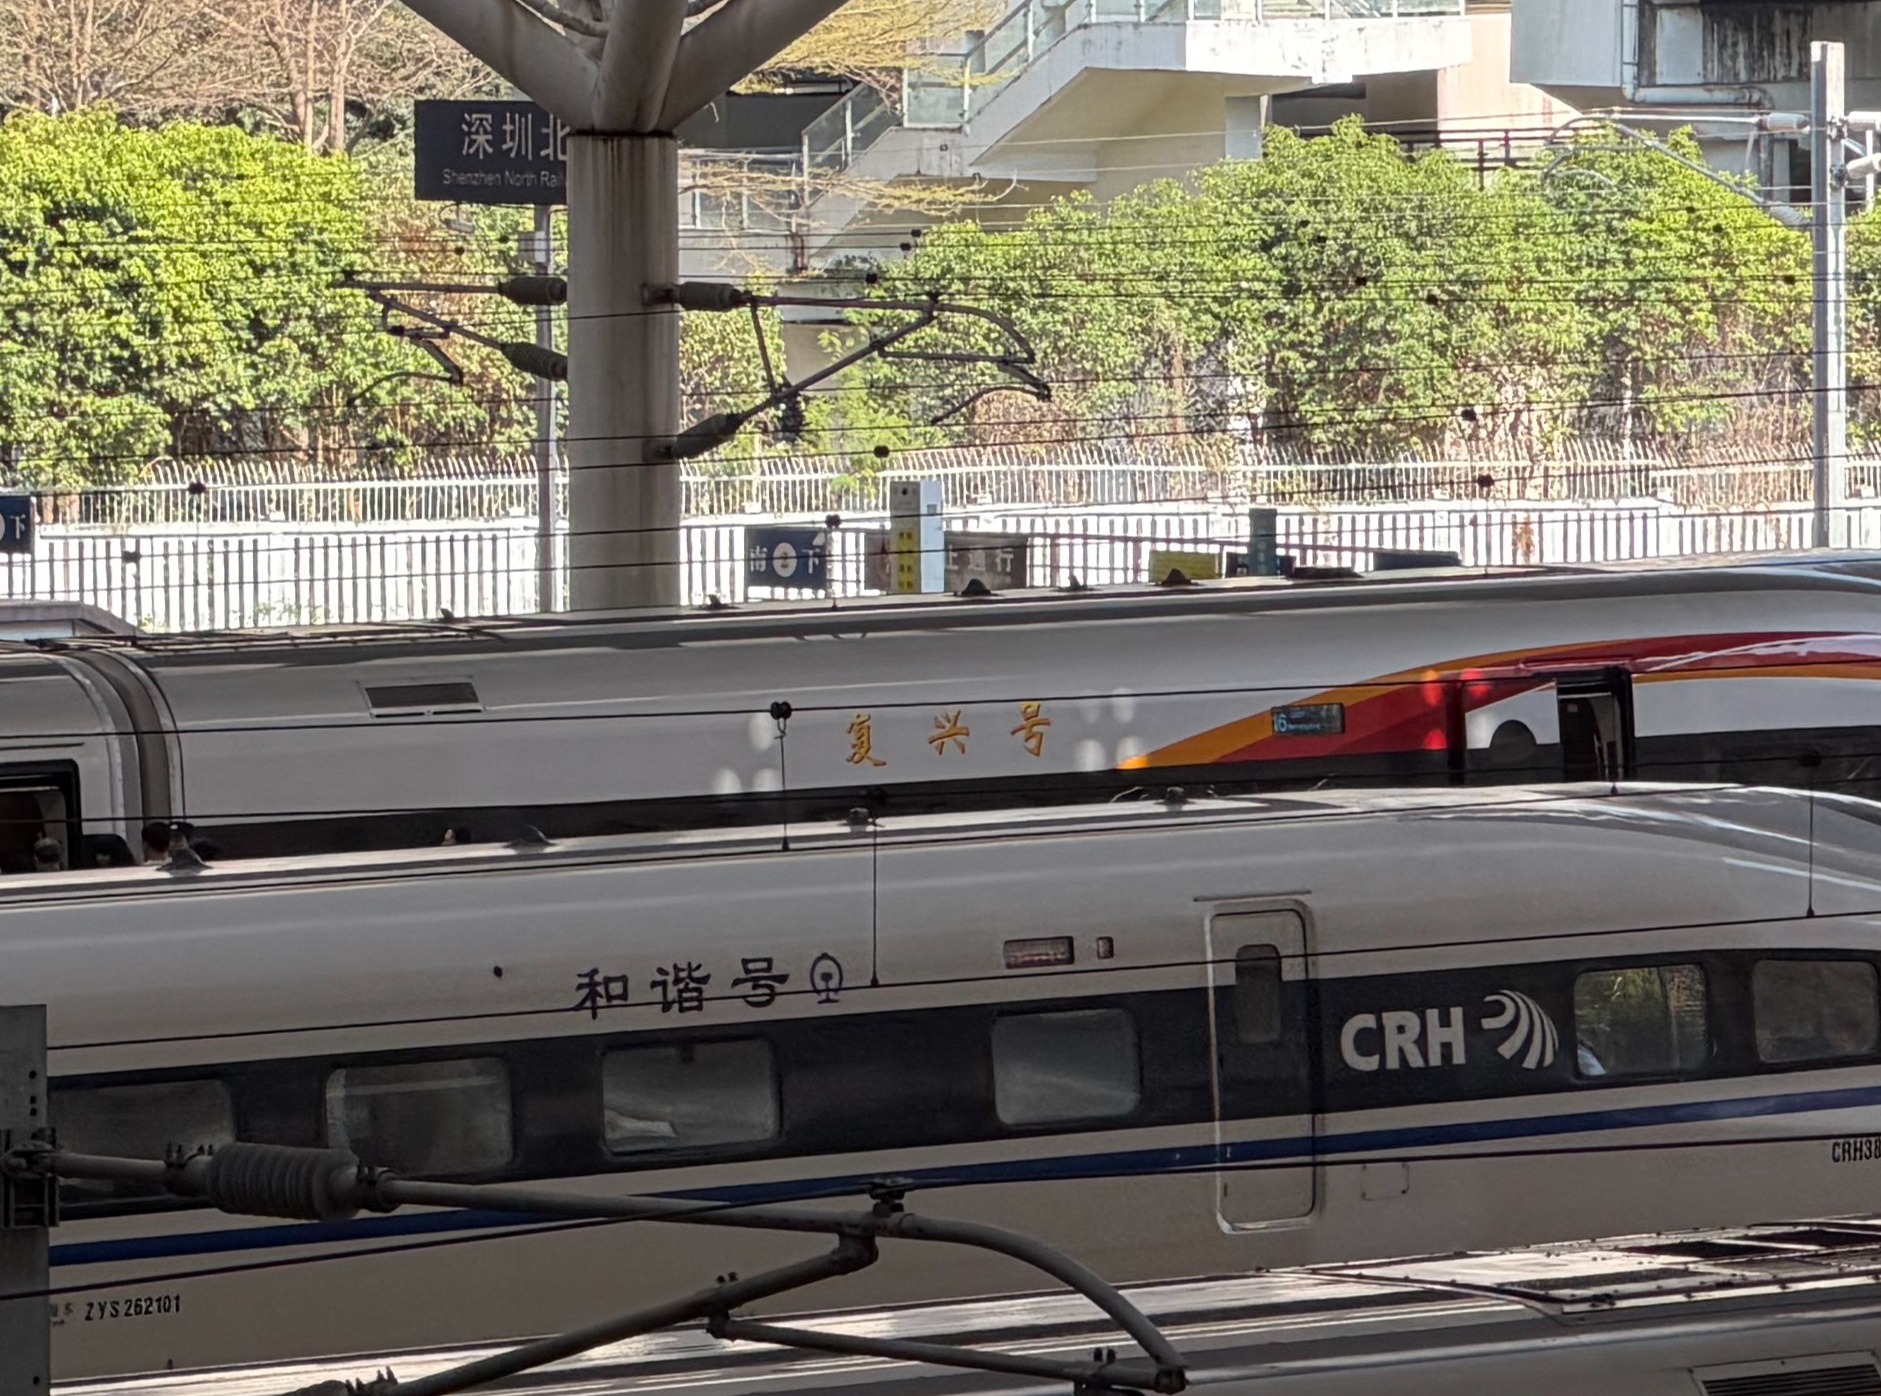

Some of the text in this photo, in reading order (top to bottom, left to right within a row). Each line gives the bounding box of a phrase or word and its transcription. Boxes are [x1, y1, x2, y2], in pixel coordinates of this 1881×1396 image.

[461, 112, 570, 161] 深圳北
[442, 168, 500, 186] Shenzhen
[505, 170, 537, 186] North
[9, 514, 26, 539] 下
[845, 702, 1052, 768] 复兴号
[573, 957, 790, 1020] 和谐号
[1341, 1006, 1466, 1072] CRH
